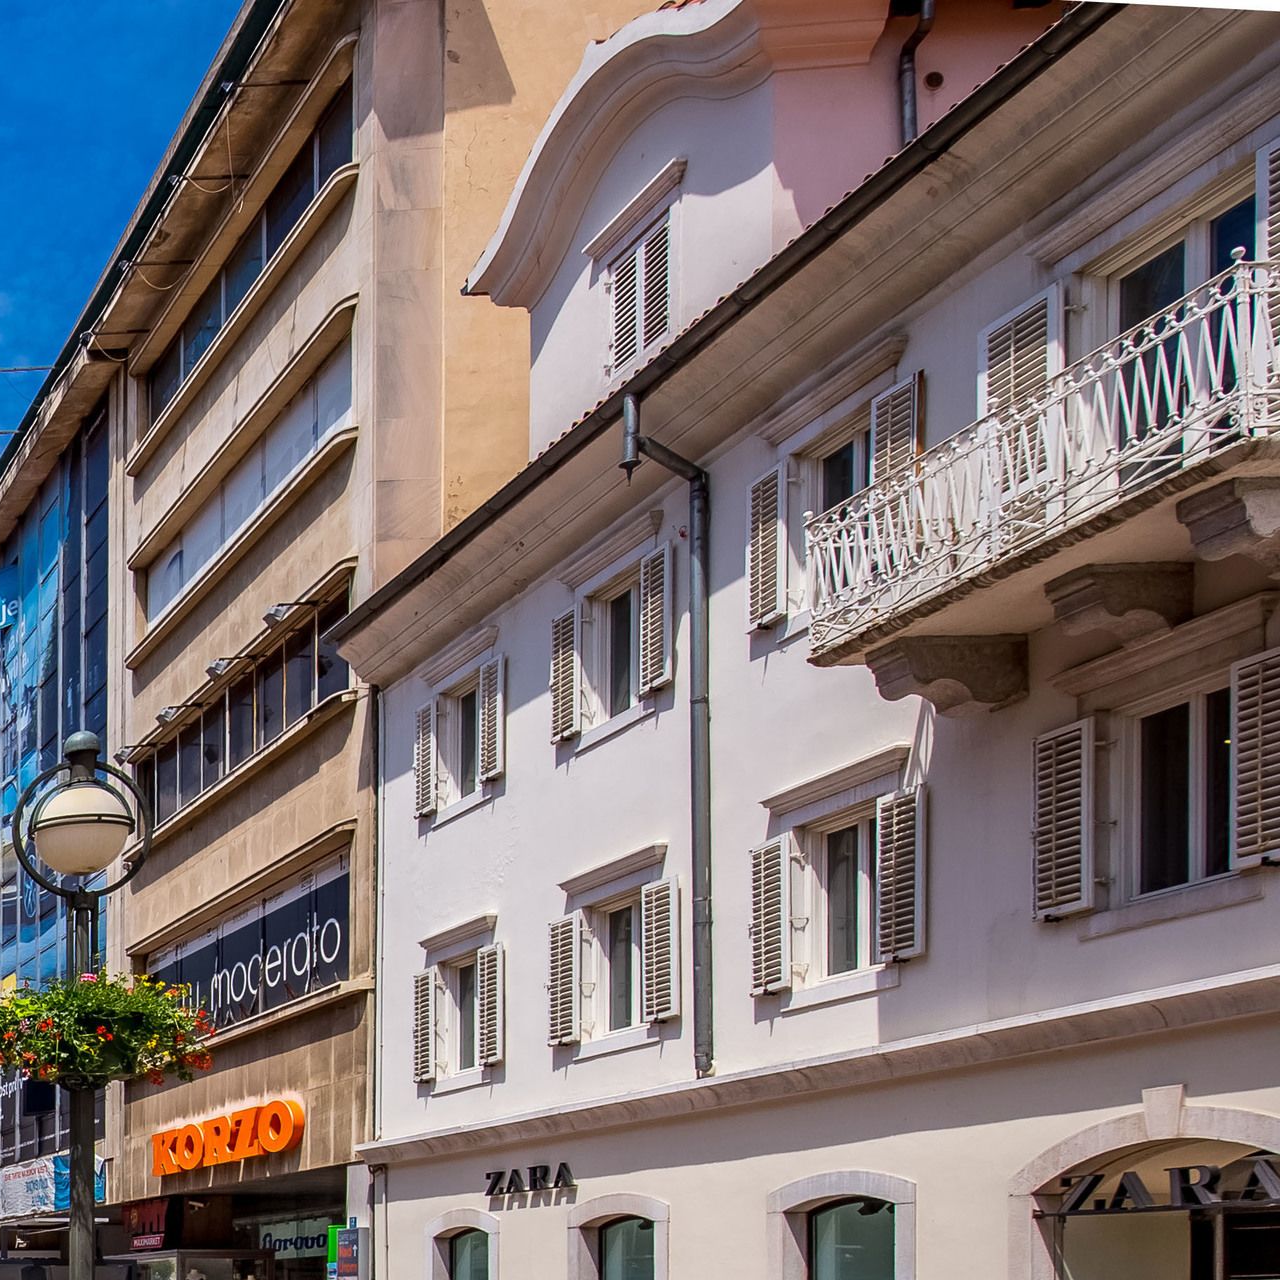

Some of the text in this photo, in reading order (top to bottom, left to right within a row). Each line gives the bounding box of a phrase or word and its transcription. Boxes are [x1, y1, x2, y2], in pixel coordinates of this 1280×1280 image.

[151, 1099, 305, 1177] KORZO
[484, 1162, 578, 1197] ZARA
[1059, 1159, 1280, 1213] ZARA
